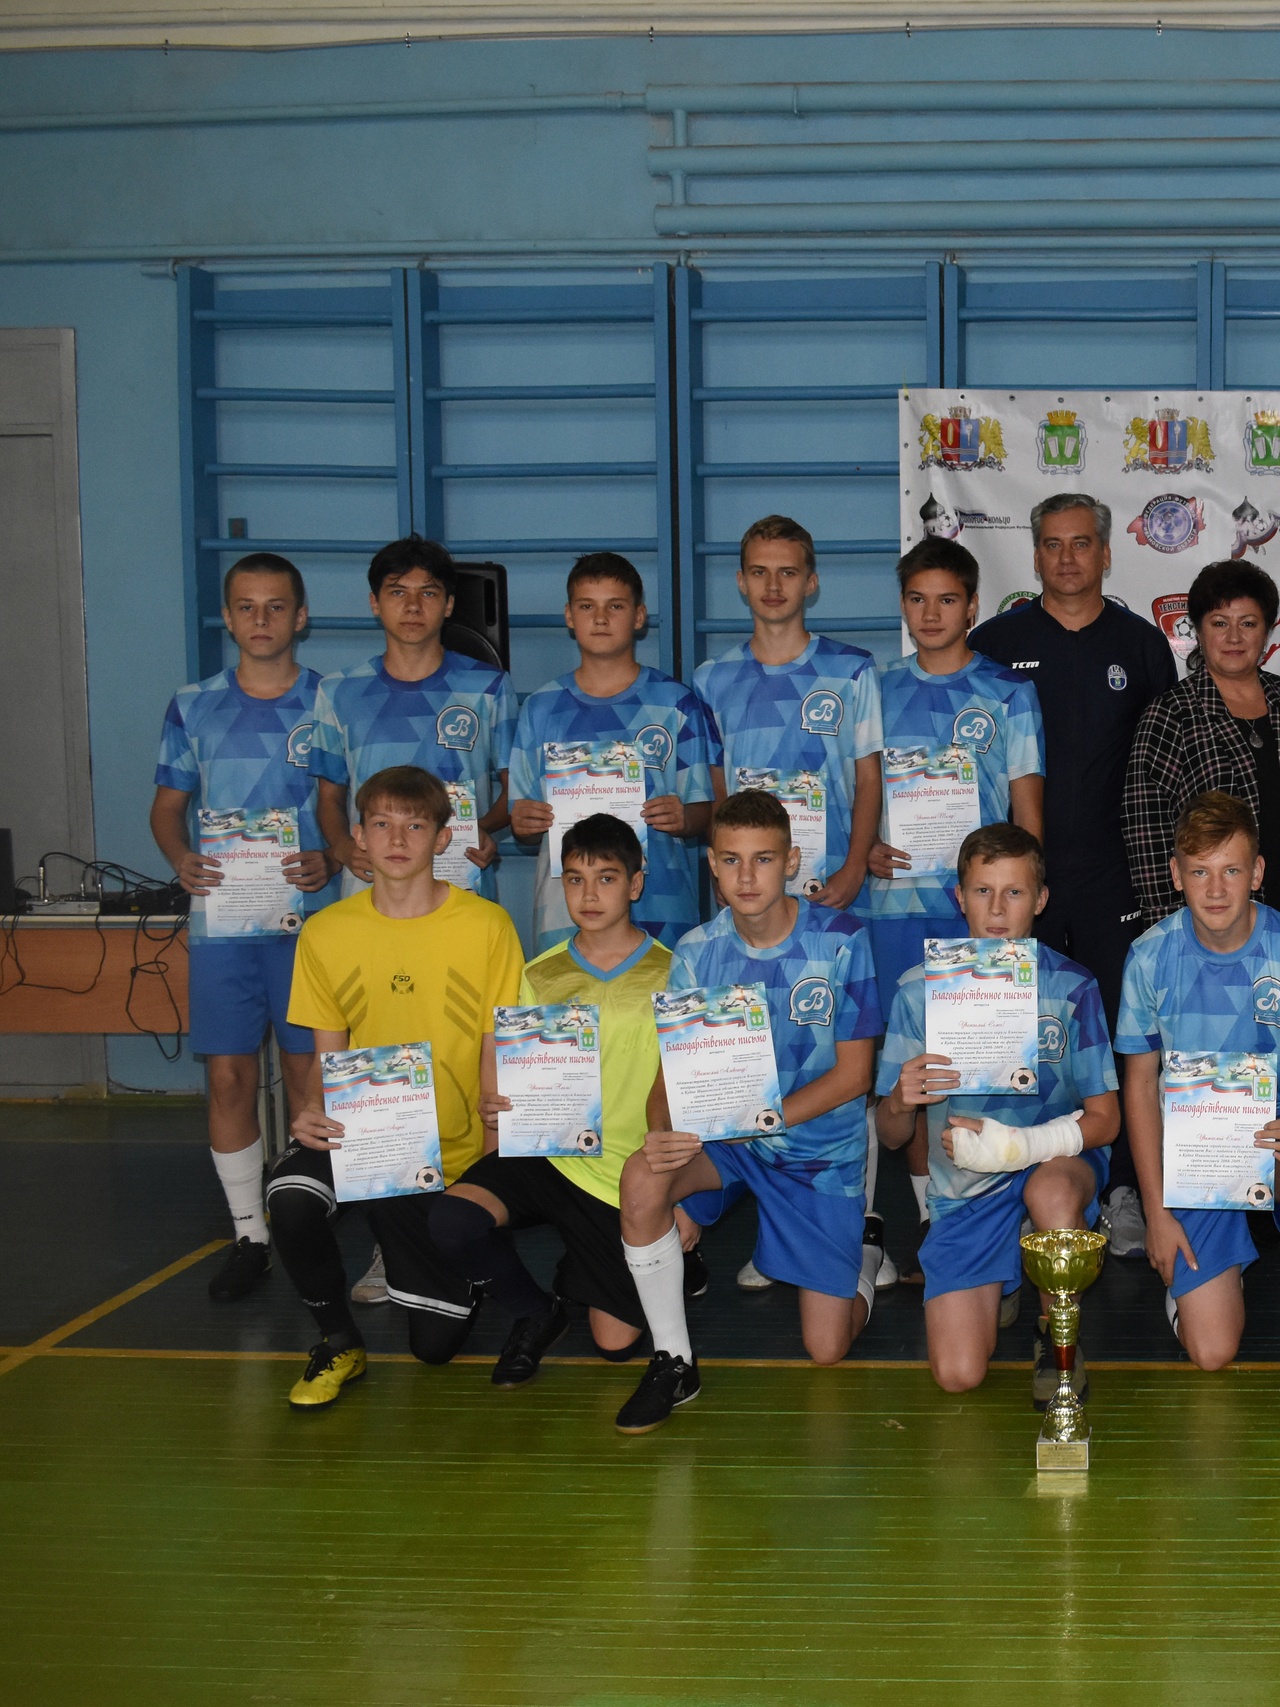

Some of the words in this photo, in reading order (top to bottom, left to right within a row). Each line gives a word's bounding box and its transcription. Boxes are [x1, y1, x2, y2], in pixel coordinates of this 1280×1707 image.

[552, 784, 614, 800] Благодарственное
[616, 786, 640, 794] письмо
[892, 786, 950, 802] Благодарственное
[208, 848, 271, 863] Благодарственное
[932, 988, 1002, 1006] Благодарственное
[1004, 990, 1032, 1000] письмо
[666, 1036, 736, 1055] Благодарственное
[738, 1034, 766, 1044] письмо
[502, 1052, 567, 1070] Благодарственное
[570, 1055, 595, 1064] письмо
[332, 1094, 400, 1114] Благодарственное
[402, 1092, 430, 1102] письмо
[1171, 1100, 1240, 1118] Благодарственное
[1242, 1104, 1270, 1115] письмо
